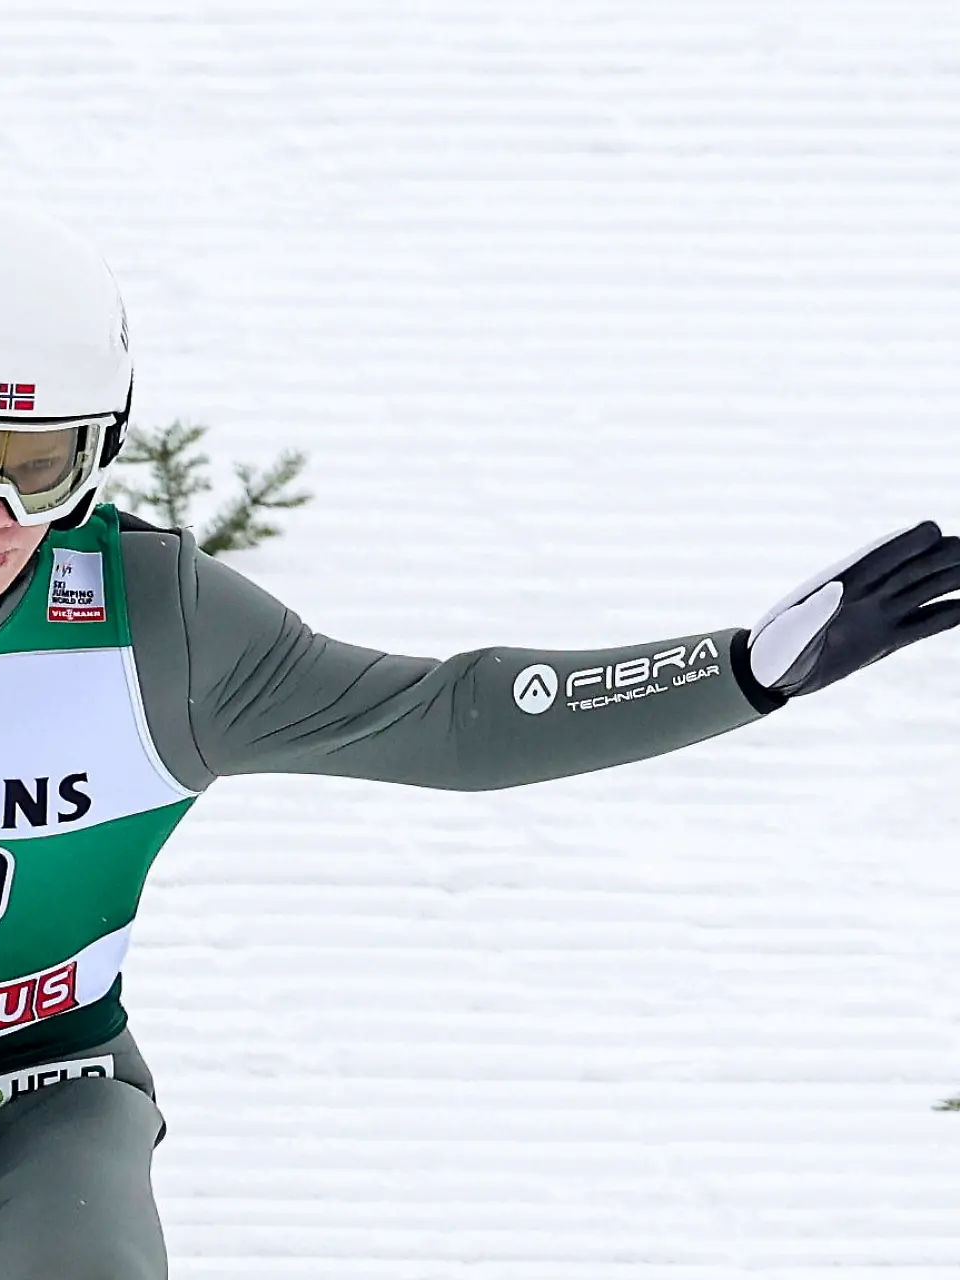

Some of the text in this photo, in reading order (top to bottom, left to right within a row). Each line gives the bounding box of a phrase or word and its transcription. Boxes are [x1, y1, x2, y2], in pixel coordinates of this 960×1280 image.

[52, 590, 94, 598] JUMPING
[565, 637, 718, 697] FIBRA
[567, 665, 720, 712] TECHNICAL WEAR
